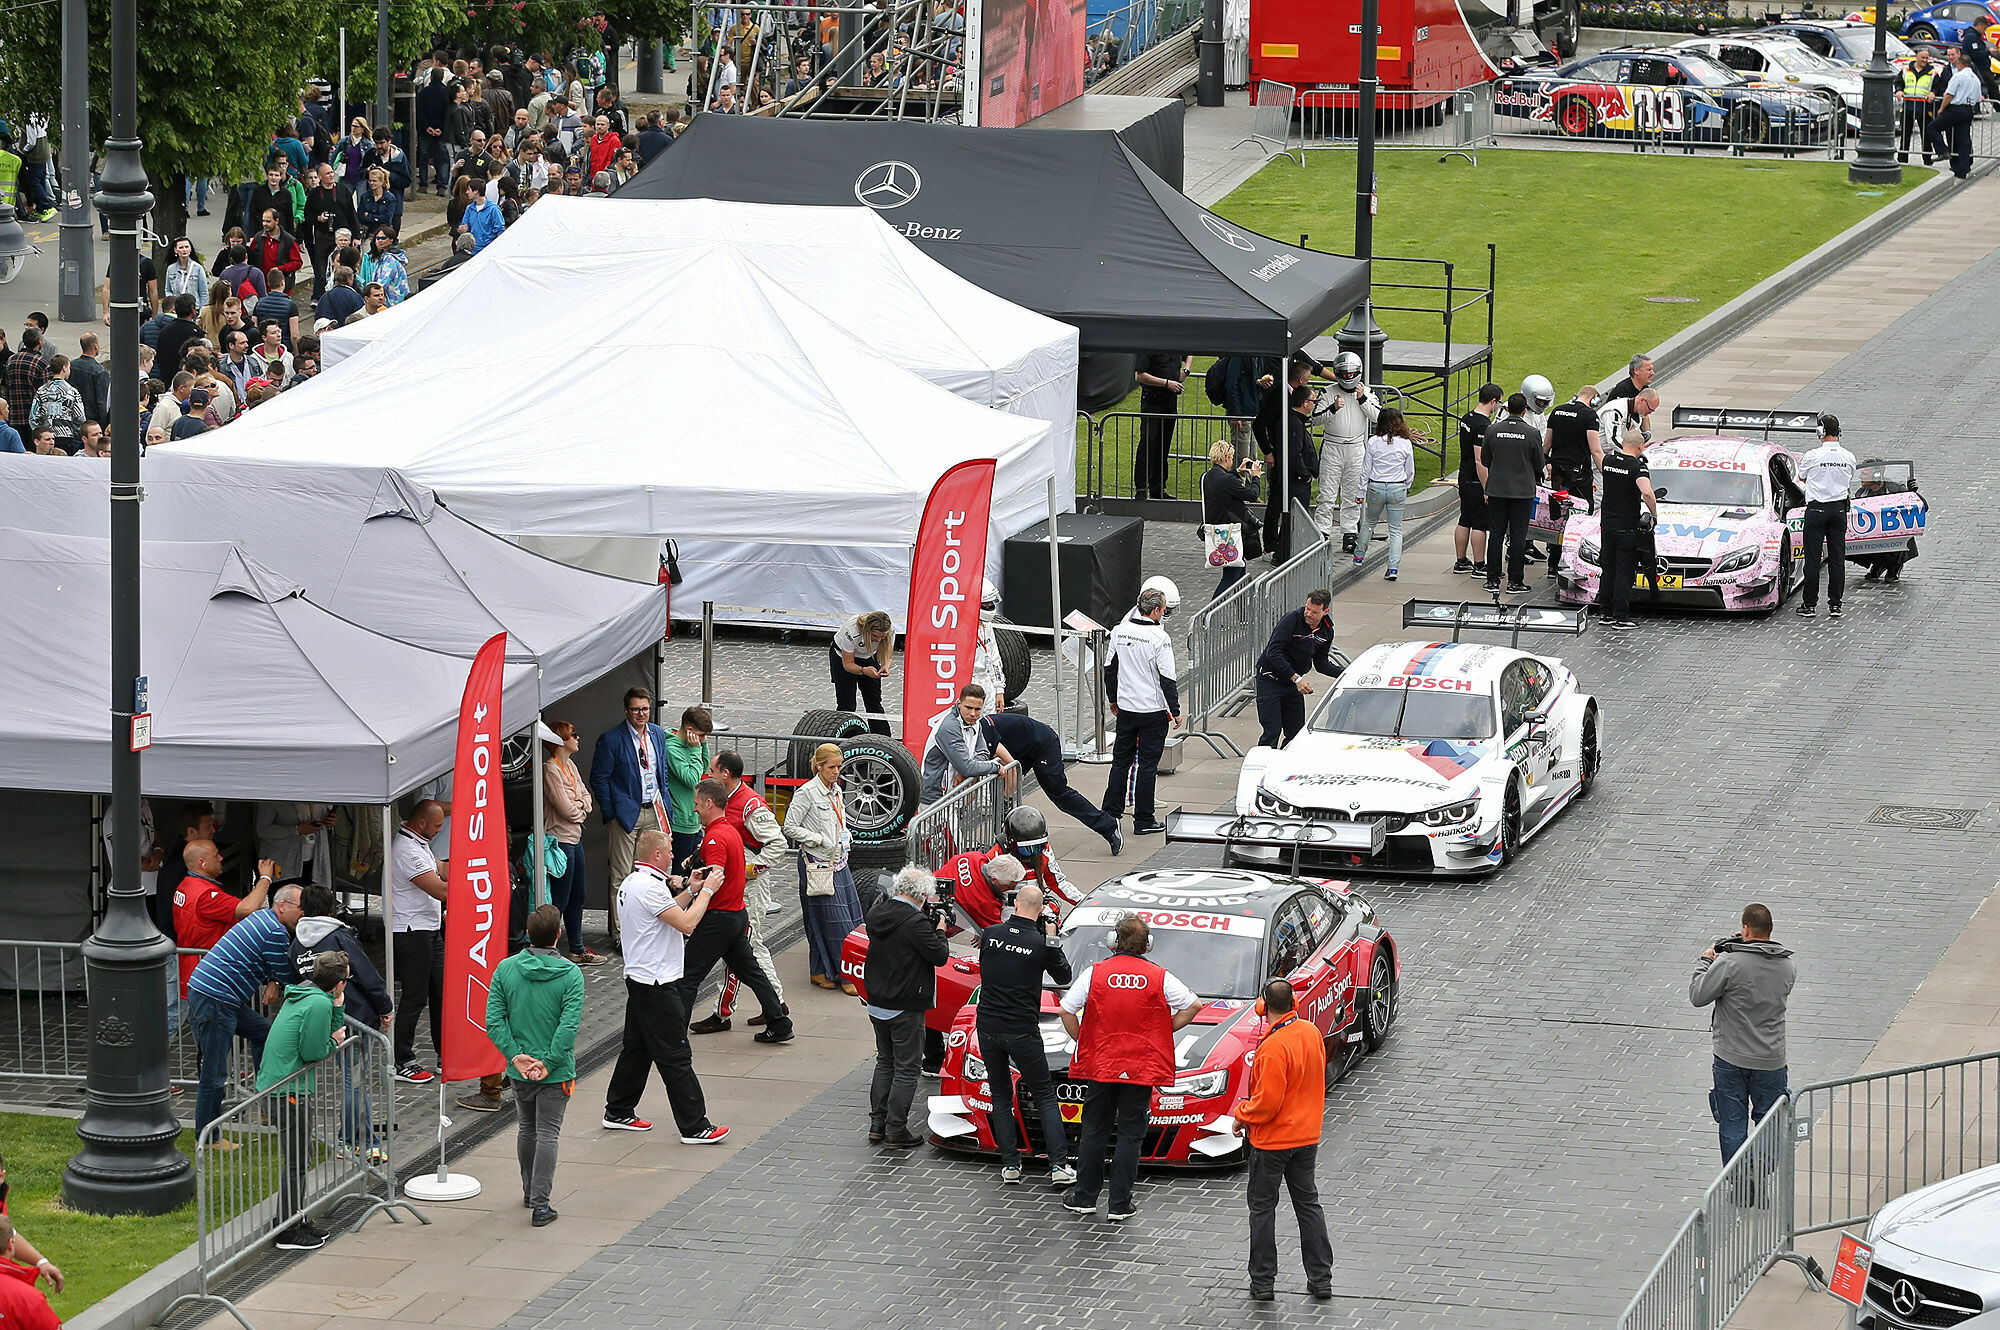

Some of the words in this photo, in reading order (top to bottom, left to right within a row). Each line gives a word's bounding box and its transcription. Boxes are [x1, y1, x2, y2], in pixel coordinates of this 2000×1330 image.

[1495, 91, 1517, 105] Red
[1519, 92, 1541, 107] Bull
[1687, 414, 1785, 425] PETRONAS
[1496, 432, 1526, 440] PETRONAS
[1603, 465, 1629, 475] PETRONAS
[1678, 459, 1746, 471] BOSCH
[1864, 541, 1904, 549] TECHNOLOGY
[930, 510, 966, 630] Sport
[1702, 578, 1738, 586] Hankook
[1388, 676, 1472, 691] BOSCH
[843, 747, 893, 760] ankook
[1299, 779, 1364, 787] PARTS
[1107, 889, 1249, 907] SOUND
[466, 857, 493, 968] Audi
[1137, 911, 1231, 931] BOSCH
[988, 938, 1005, 949] TV
[1005, 943, 1033, 956] crew
[1316, 984, 1333, 1016] Audi
[1332, 970, 1353, 1001] Sport
[1153, 1112, 1205, 1125] Hankook
